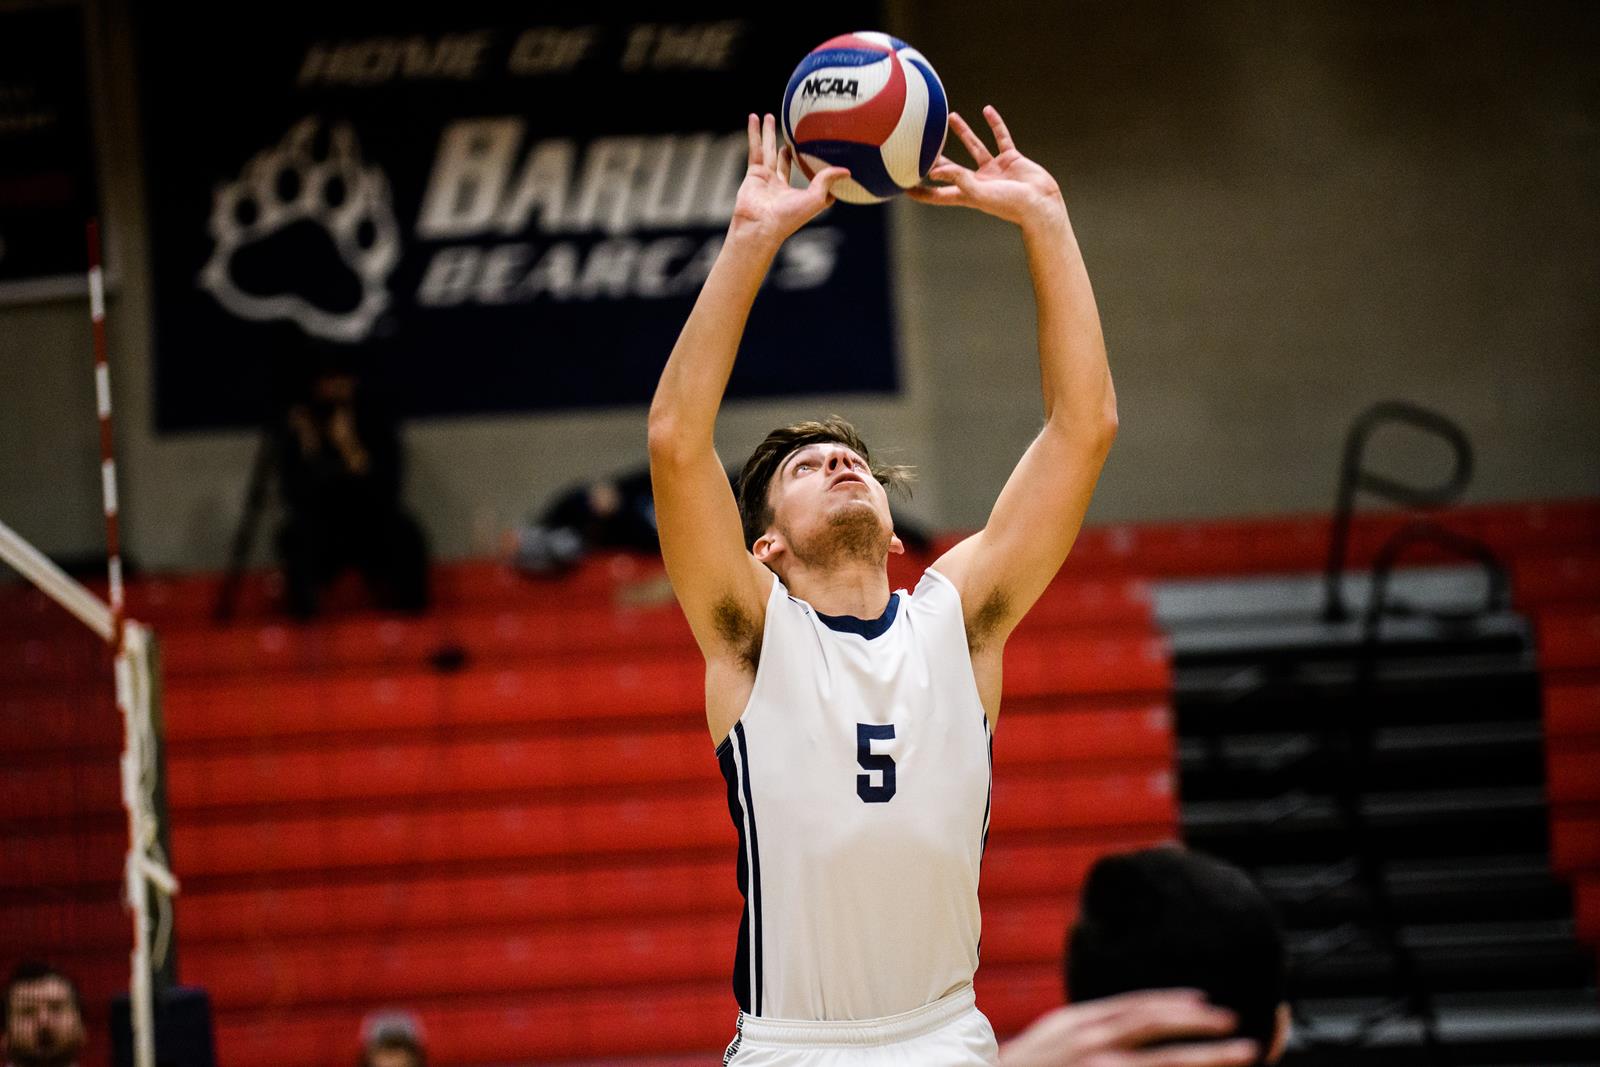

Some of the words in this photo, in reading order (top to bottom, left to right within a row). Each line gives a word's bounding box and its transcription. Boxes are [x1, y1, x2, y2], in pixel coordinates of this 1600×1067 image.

[802, 78, 858, 98] NCAA
[416, 226, 842, 306] BEARCS
[856, 723, 896, 803] 5
